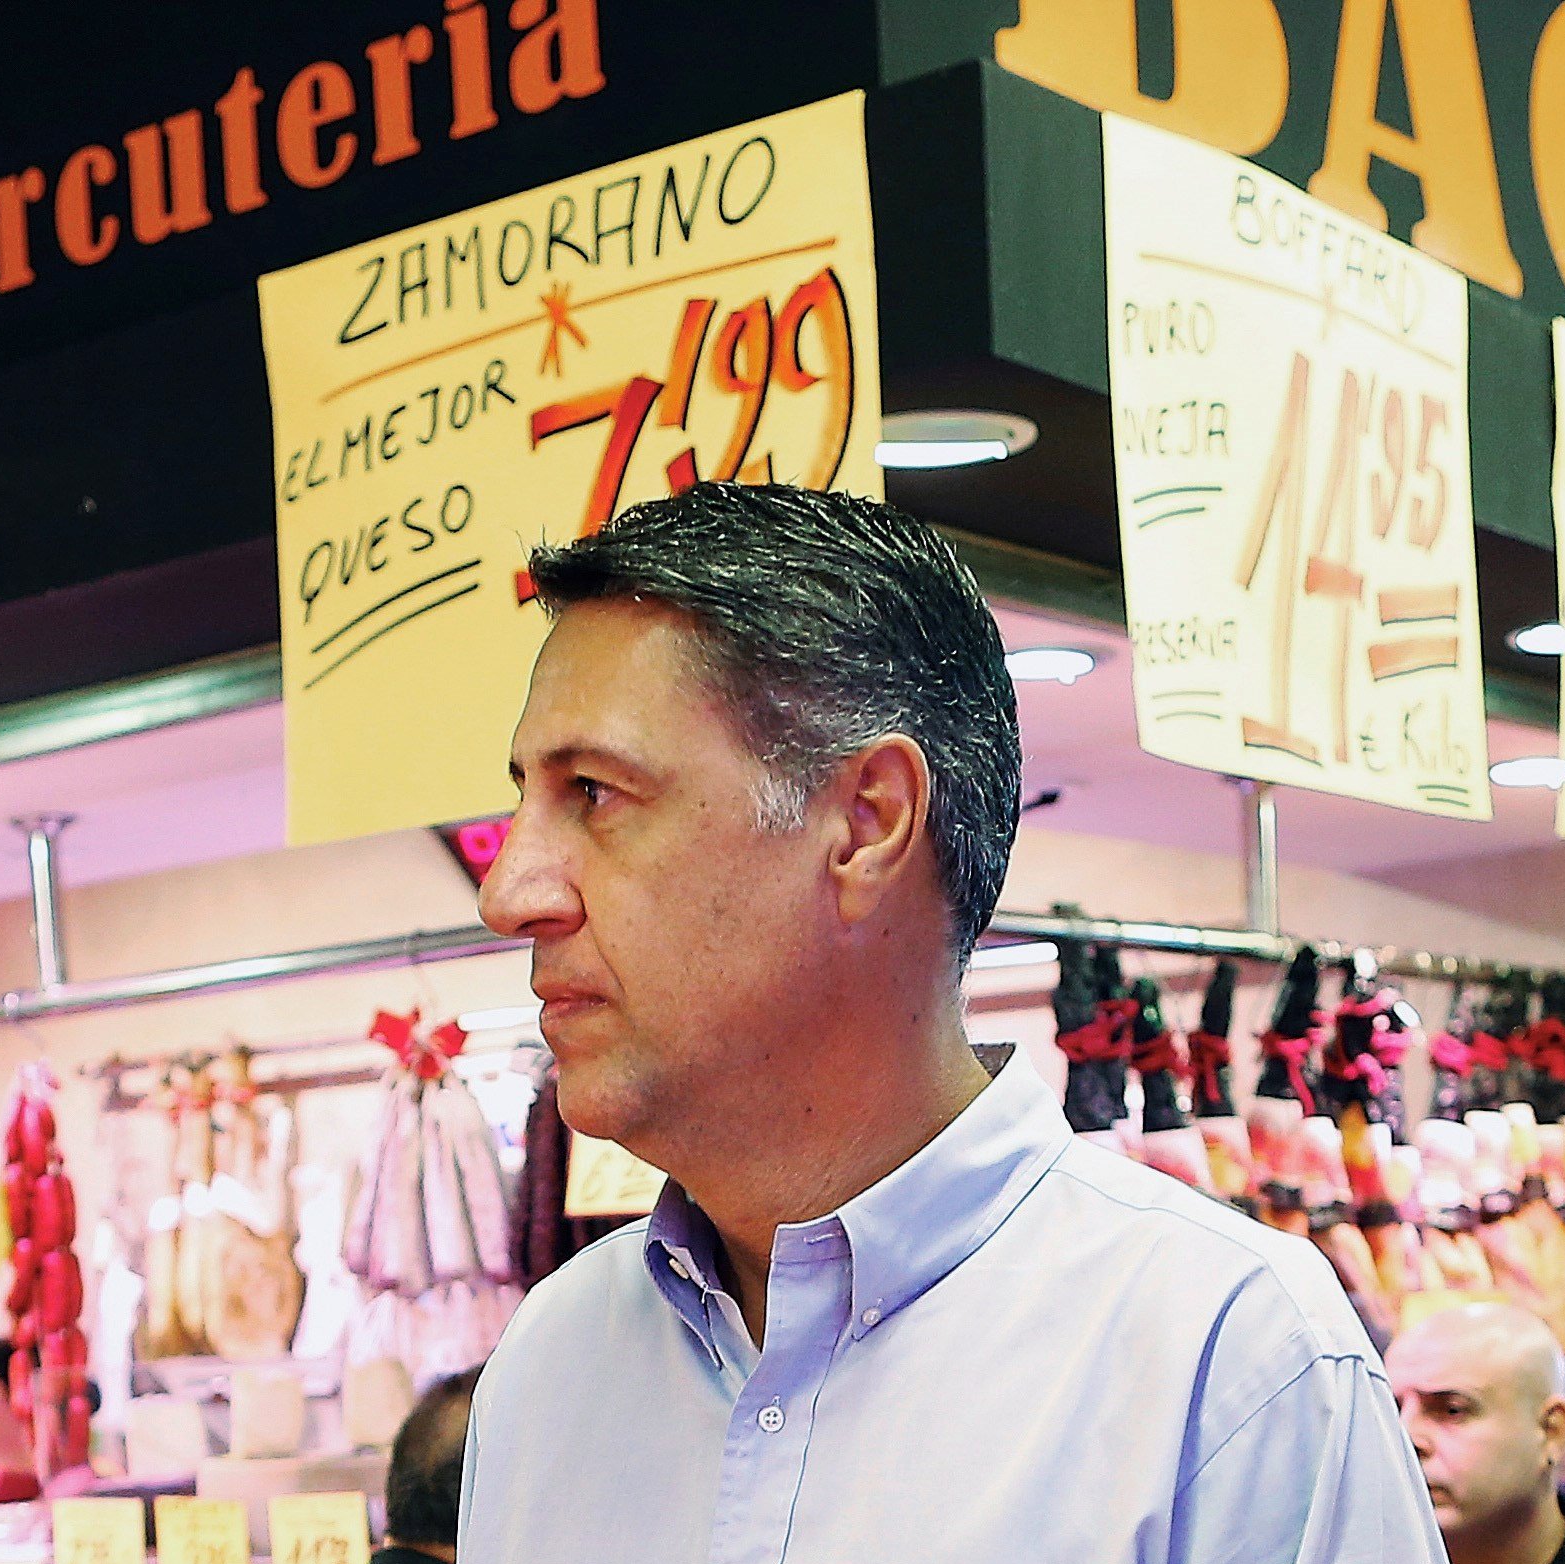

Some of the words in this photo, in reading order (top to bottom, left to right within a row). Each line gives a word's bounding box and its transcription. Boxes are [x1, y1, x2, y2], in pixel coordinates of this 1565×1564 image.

[338, 136, 775, 346] ZAMORANO
[1230, 174, 1424, 336] BOFFARD
[1123, 302, 1216, 357] PURO
[299, 483, 474, 622] QUESO
